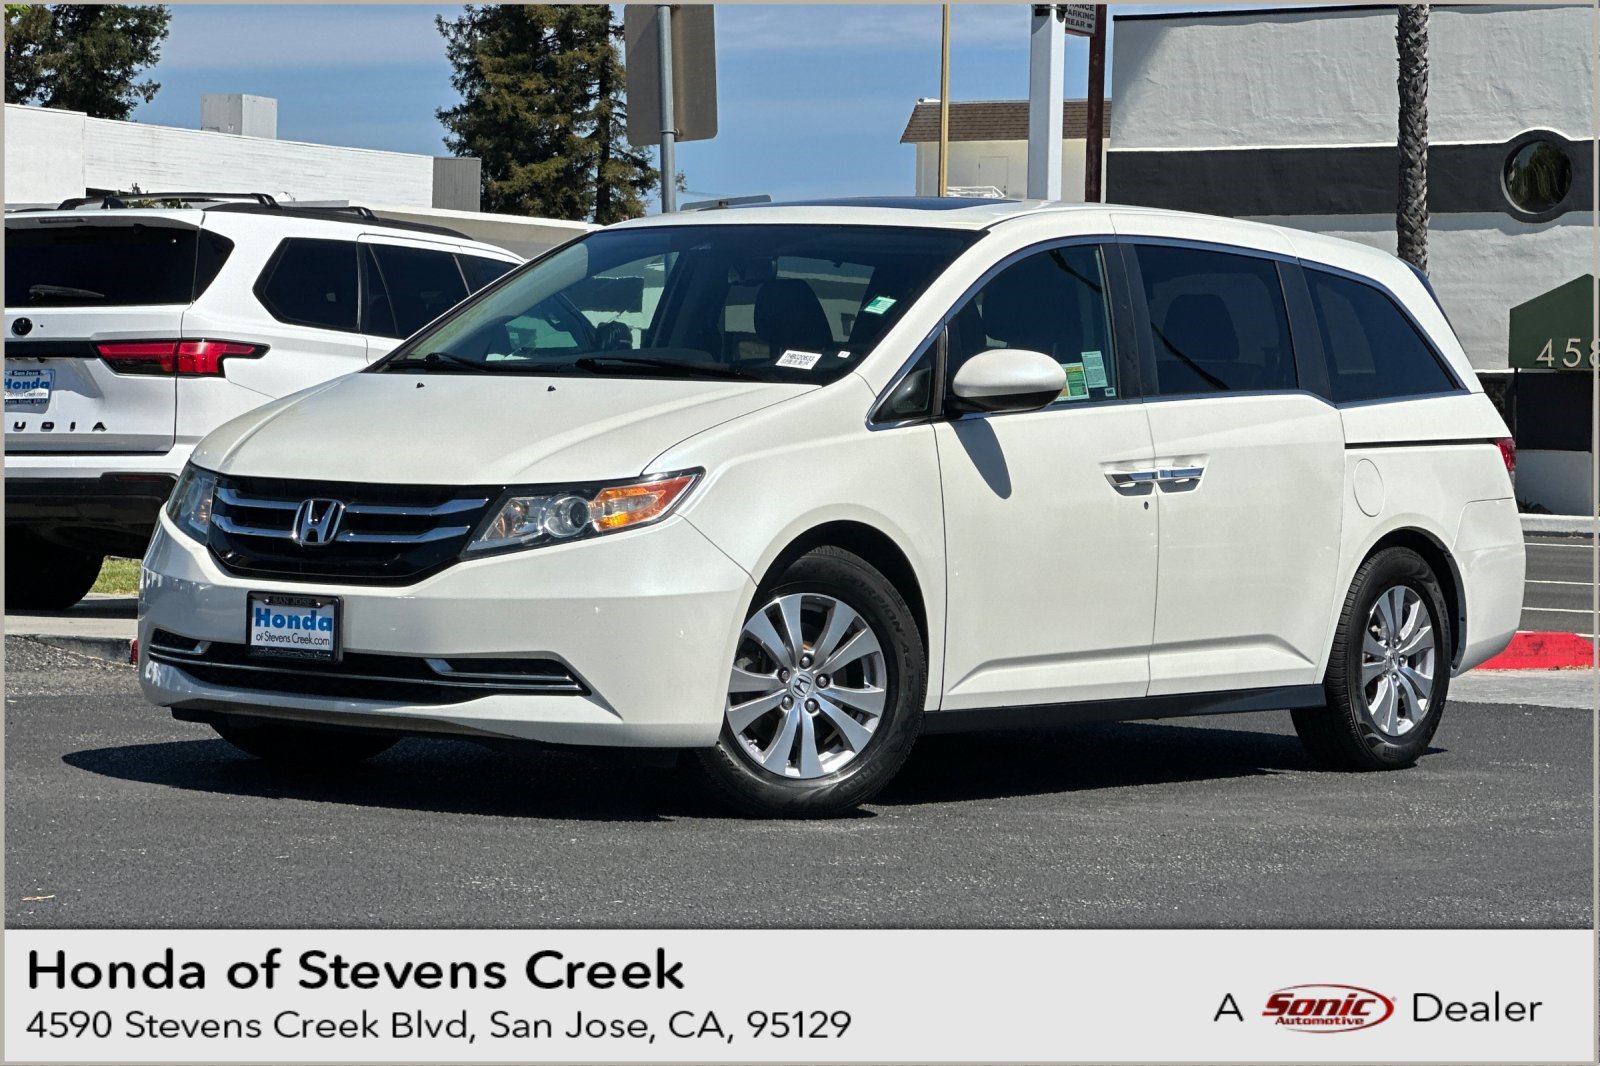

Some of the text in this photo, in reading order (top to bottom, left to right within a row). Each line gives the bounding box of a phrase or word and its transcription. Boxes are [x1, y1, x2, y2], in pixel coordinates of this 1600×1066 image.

[1066, 17, 1085, 28] REAR
[255, 607, 333, 632] Honda
[256, 631, 330, 646] of Stevens Creek.com
